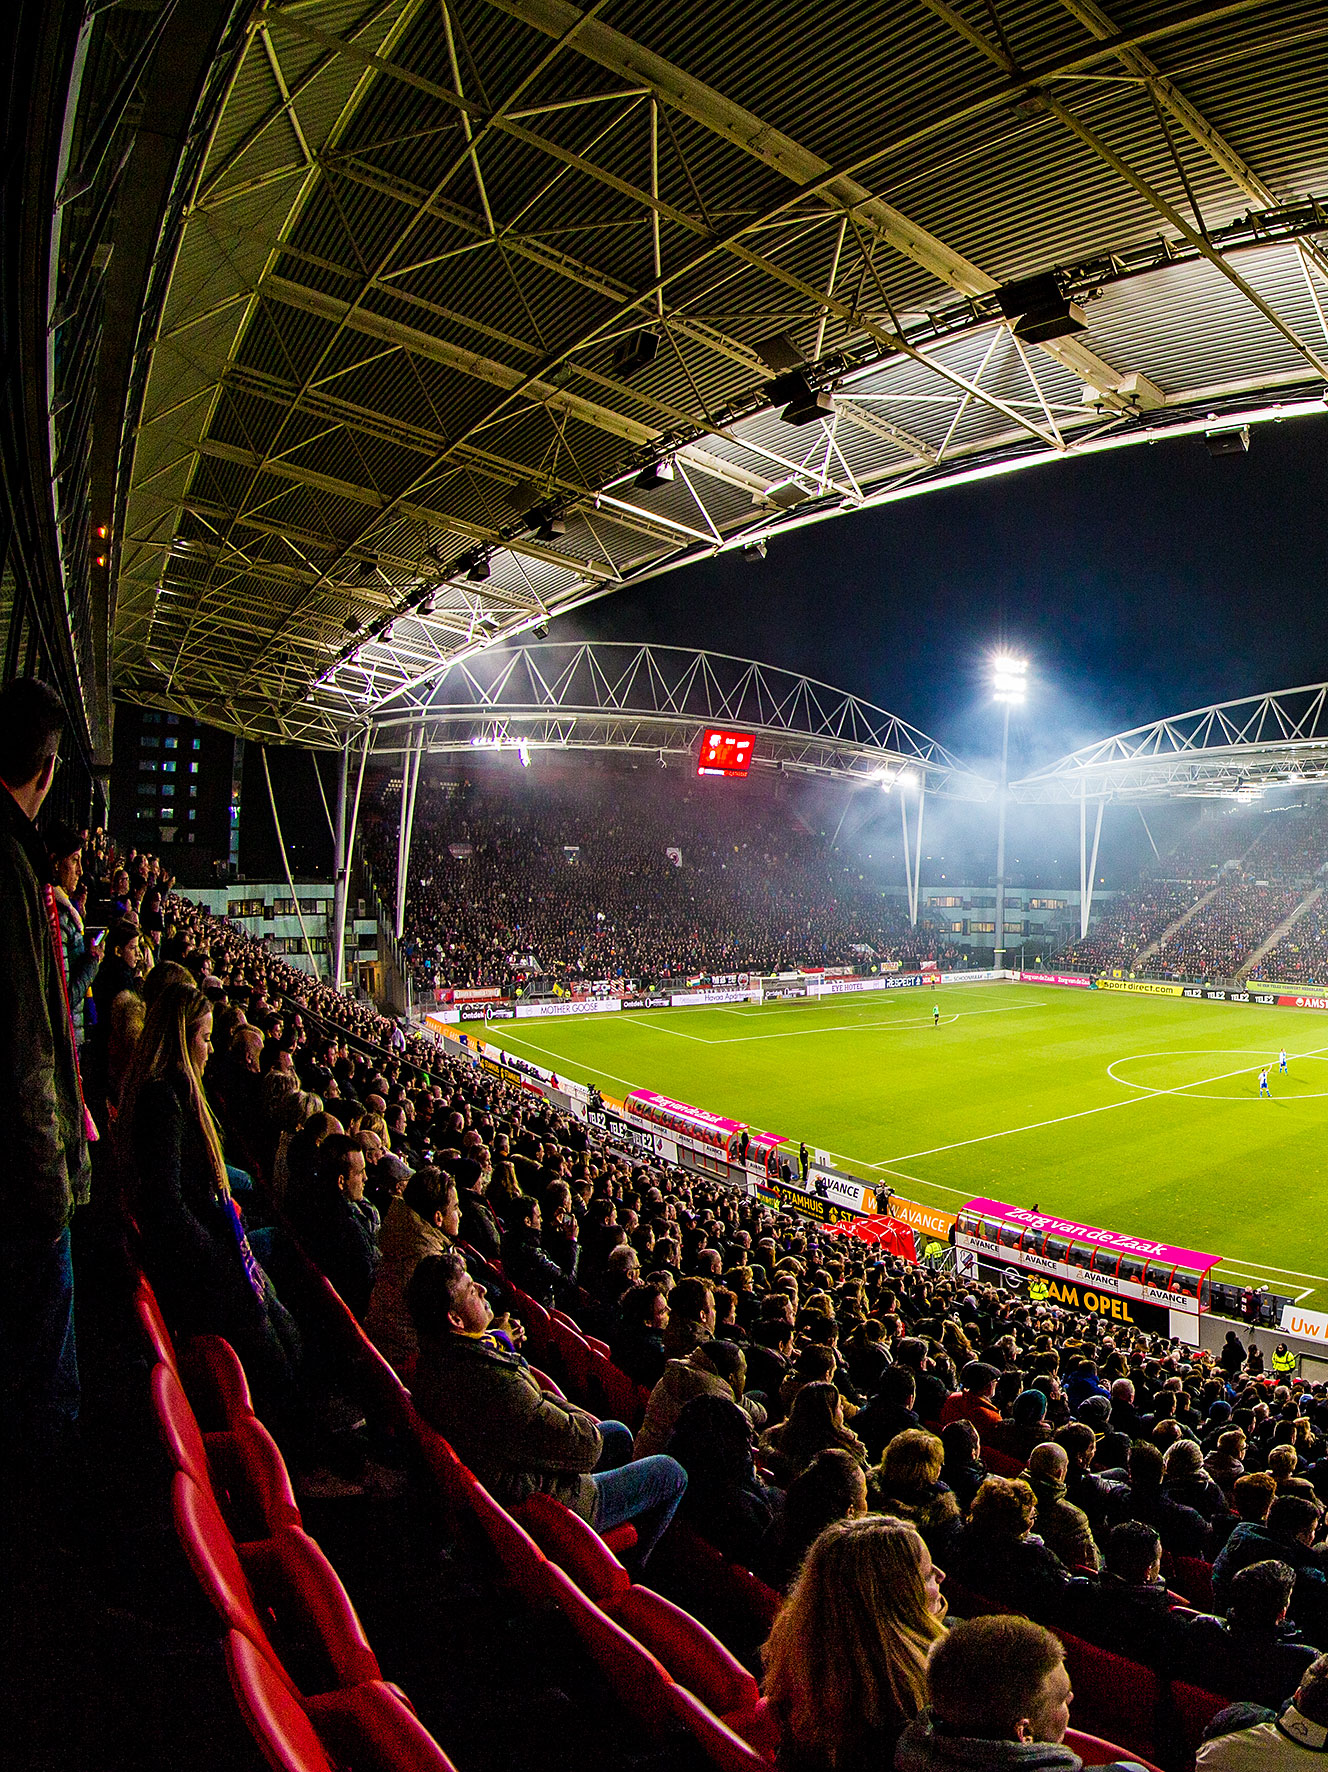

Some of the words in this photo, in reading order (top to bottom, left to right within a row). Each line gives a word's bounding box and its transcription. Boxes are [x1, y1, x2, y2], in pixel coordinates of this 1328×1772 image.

[831, 984, 845, 992] EYE
[845, 983, 864, 991] HOTEL
[886, 977, 915, 988] RESPECT
[1184, 989, 1202, 998] TELE2
[1207, 991, 1225, 1000] TELE2
[1231, 993, 1249, 1002] TELE2
[1255, 995, 1275, 1004] TELE2
[462, 1012, 485, 1020] Ontdek
[541, 1004, 571, 1015] MOTHER
[572, 1002, 598, 1013] GOOSE
[588, 1111, 607, 1130] TELE2
[610, 1121, 628, 1139] TELE2
[822, 1176, 860, 1199] AVANCE
[782, 1189, 824, 1215] STAMHUIS
[1005, 1207, 1051, 1228] Zorg
[1049, 1219, 1085, 1238] van
[1085, 1227, 1115, 1244] de
[1110, 1234, 1168, 1256] Zaak
[969, 1237, 999, 1252] AVANCE
[1024, 1254, 1057, 1270] AVANCE
[1084, 1271, 1119, 1287] AVANCE
[1149, 1288, 1187, 1305] AVANCE
[1083, 1291, 1135, 1323] OPEL
[1291, 1316, 1320, 1336] Uw
